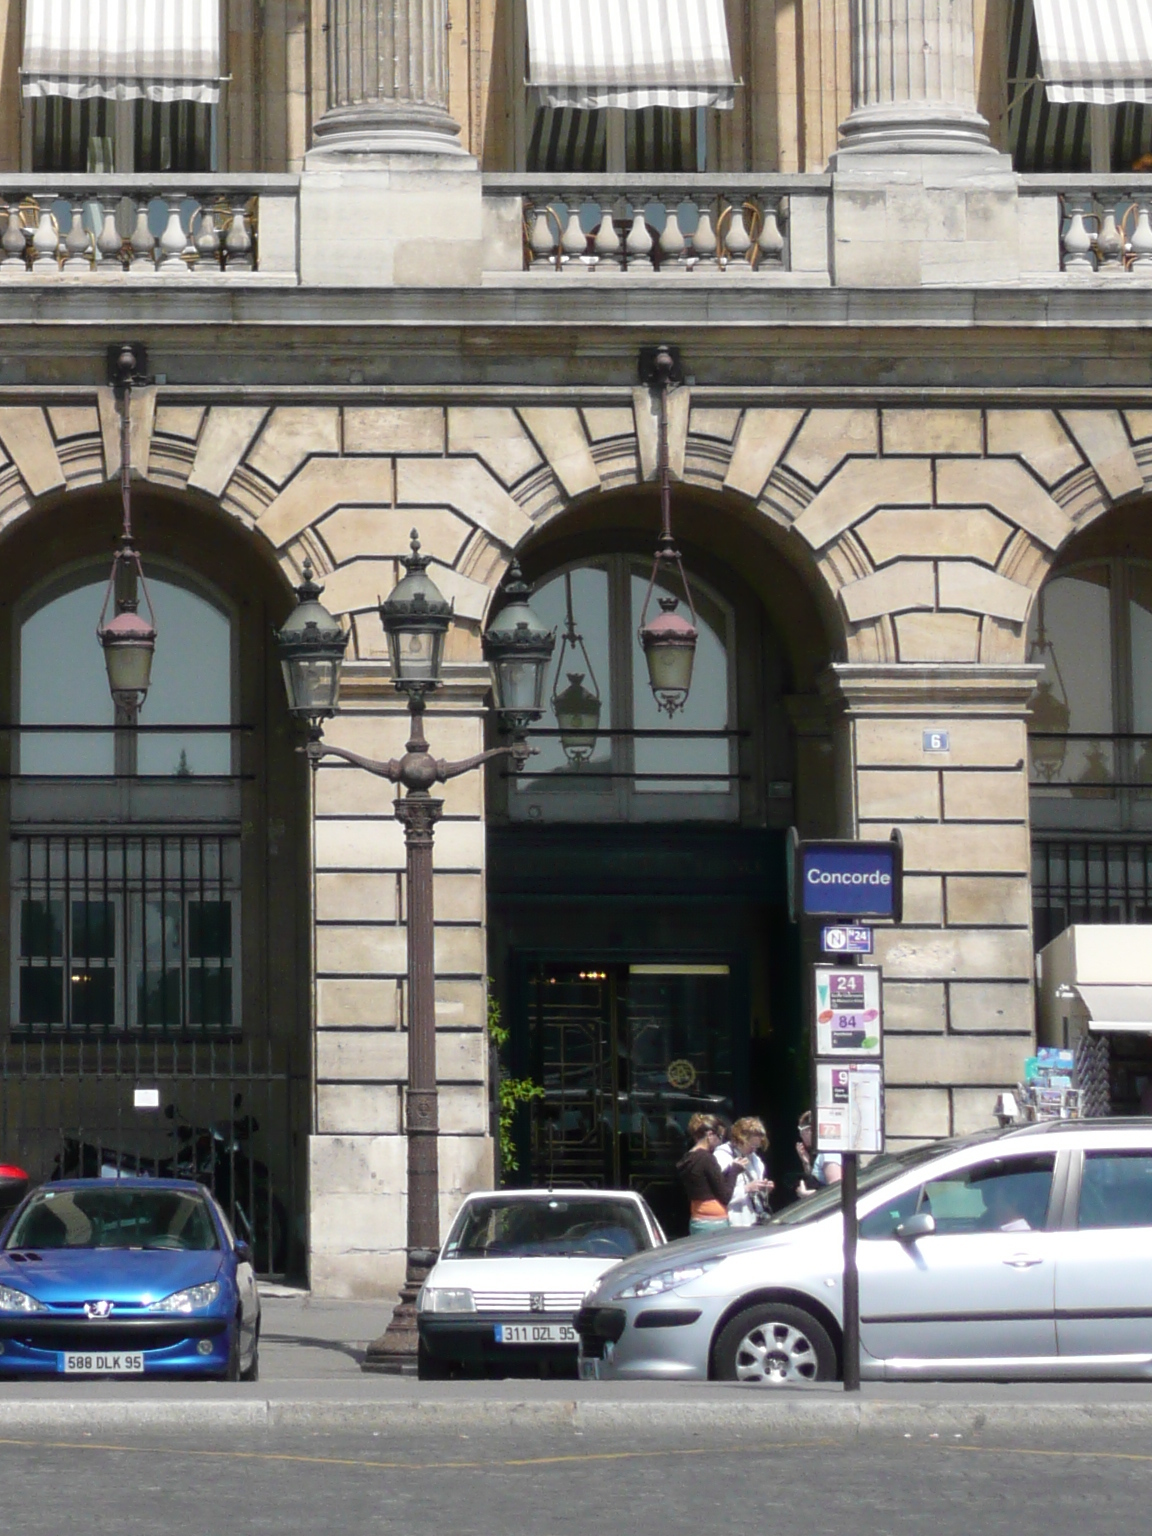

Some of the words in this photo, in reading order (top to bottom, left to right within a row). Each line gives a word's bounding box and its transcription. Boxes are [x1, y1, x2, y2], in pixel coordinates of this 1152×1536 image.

[931, 734, 941, 749] 6
[806, 868, 891, 885] Concorde
[836, 976, 856, 990] 24
[838, 1015, 856, 1028] 84
[504, 1327, 528, 1341] 311
[559, 1326, 575, 1341] 95
[68, 1356, 92, 1369] 588
[96, 1356, 121, 1369] DLK
[125, 1356, 141, 1369] 95
